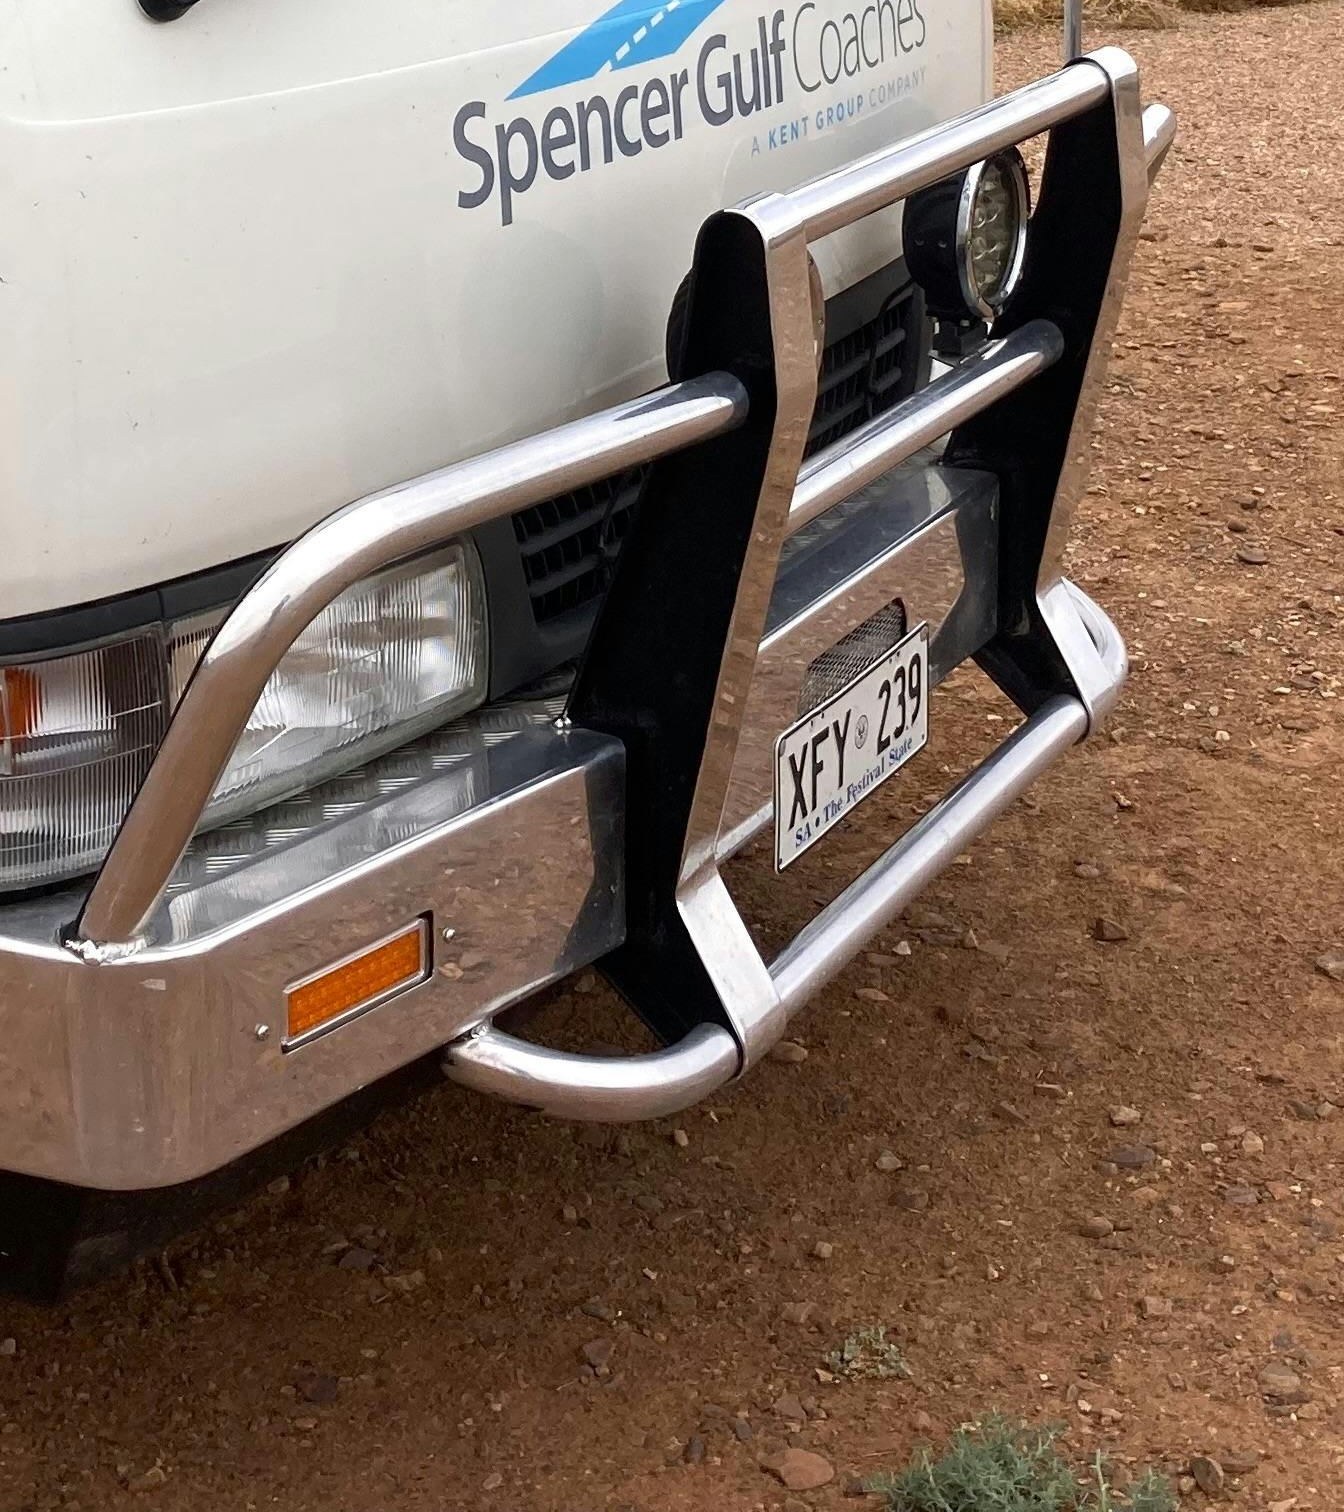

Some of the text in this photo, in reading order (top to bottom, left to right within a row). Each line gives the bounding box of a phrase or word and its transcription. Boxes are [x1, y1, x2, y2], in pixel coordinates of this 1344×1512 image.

[452, 69, 690, 227] Spencer
[698, 9, 787, 127] Gulf
[750, 68, 927, 157] A KENT GROUP COMPANY
[787, 652, 922, 831] XFY 239
[794, 737, 913, 848] SA The Festival State
